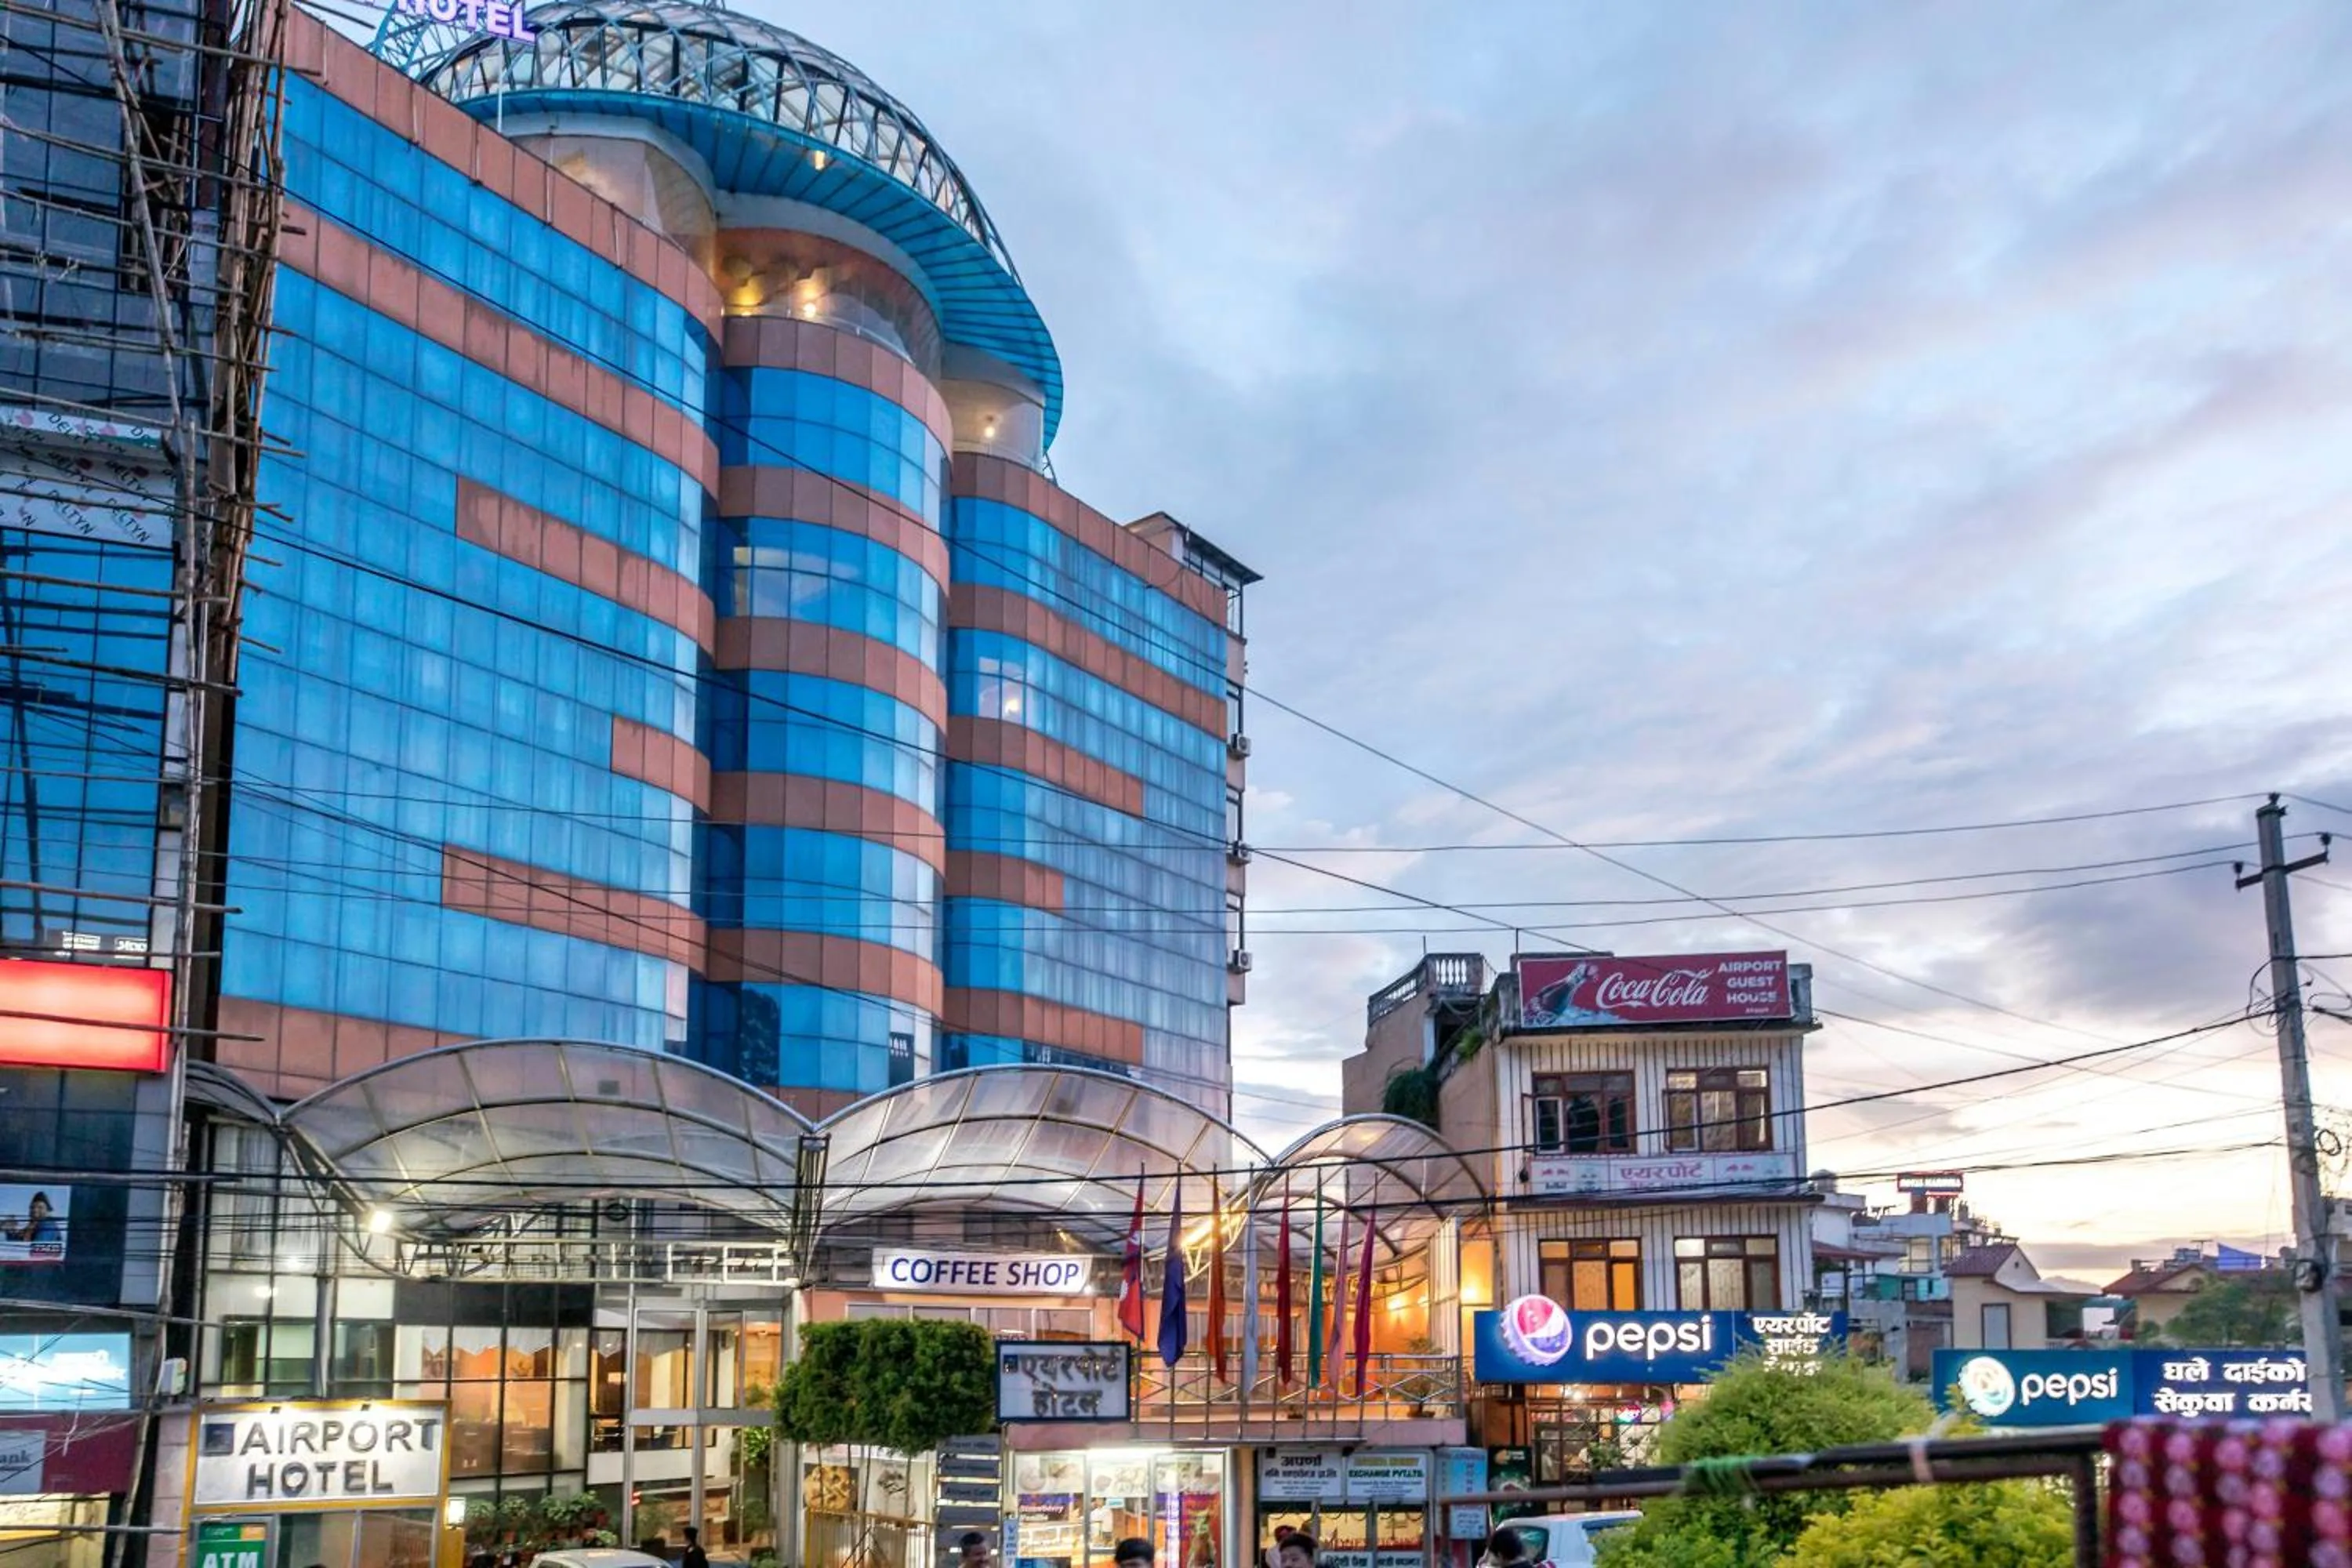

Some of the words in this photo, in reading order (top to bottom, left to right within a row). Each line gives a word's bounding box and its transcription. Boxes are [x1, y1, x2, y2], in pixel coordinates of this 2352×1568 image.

[1718, 960, 1783, 973] AIRPORT
[1595, 968, 1714, 1009] Coca-Cola
[1726, 976, 1775, 989] GUEST
[1726, 991, 1777, 1004] HOUSE
[891, 1258, 999, 1285] COFFEE
[1007, 1261, 1080, 1286] SHOP
[1586, 1315, 1714, 1360] pepsi
[2022, 1367, 2118, 1406] pepsi
[240, 1419, 441, 1456] AIRPORT
[0, 1450, 31, 1463] ank
[247, 1460, 394, 1499] HOTEL
[203, 1552, 258, 1568] ATM
